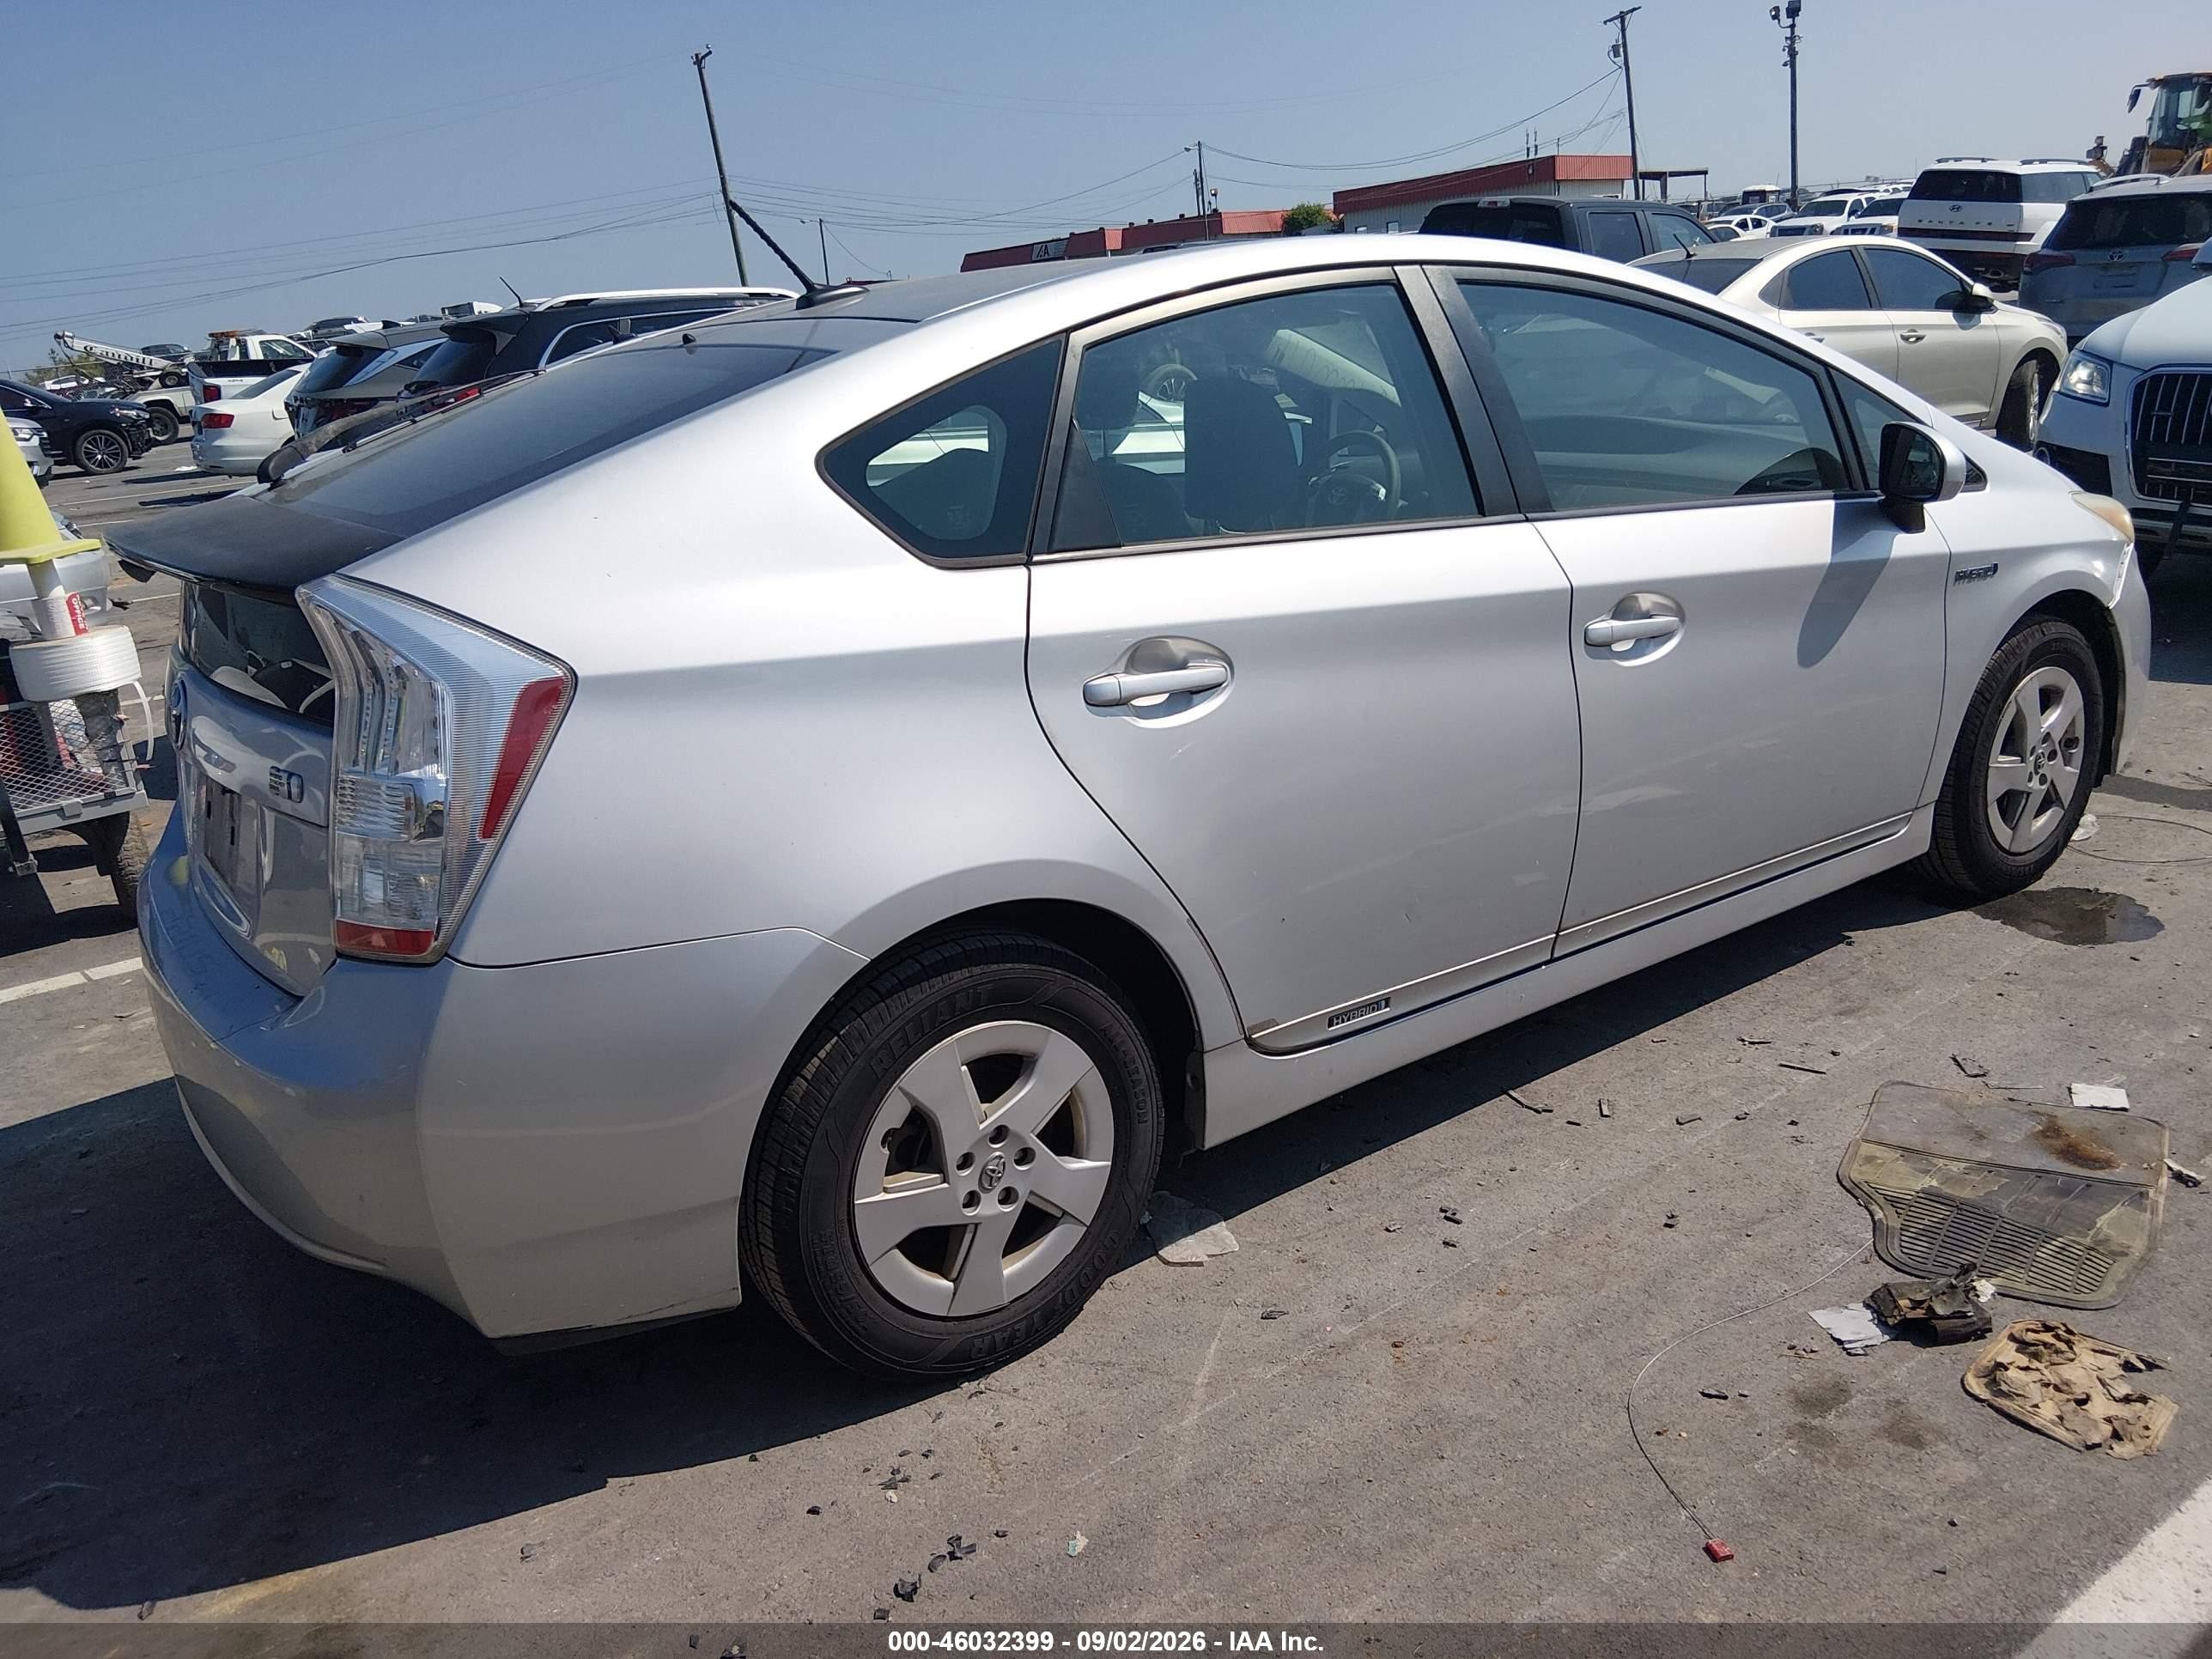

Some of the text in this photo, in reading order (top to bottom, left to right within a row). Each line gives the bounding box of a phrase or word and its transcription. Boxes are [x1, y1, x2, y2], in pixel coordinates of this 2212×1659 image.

[71, 598, 86, 629] OFFICE
[1332, 1001, 1383, 1026] HYBRID
[870, 984, 994, 1081] RELIANT
